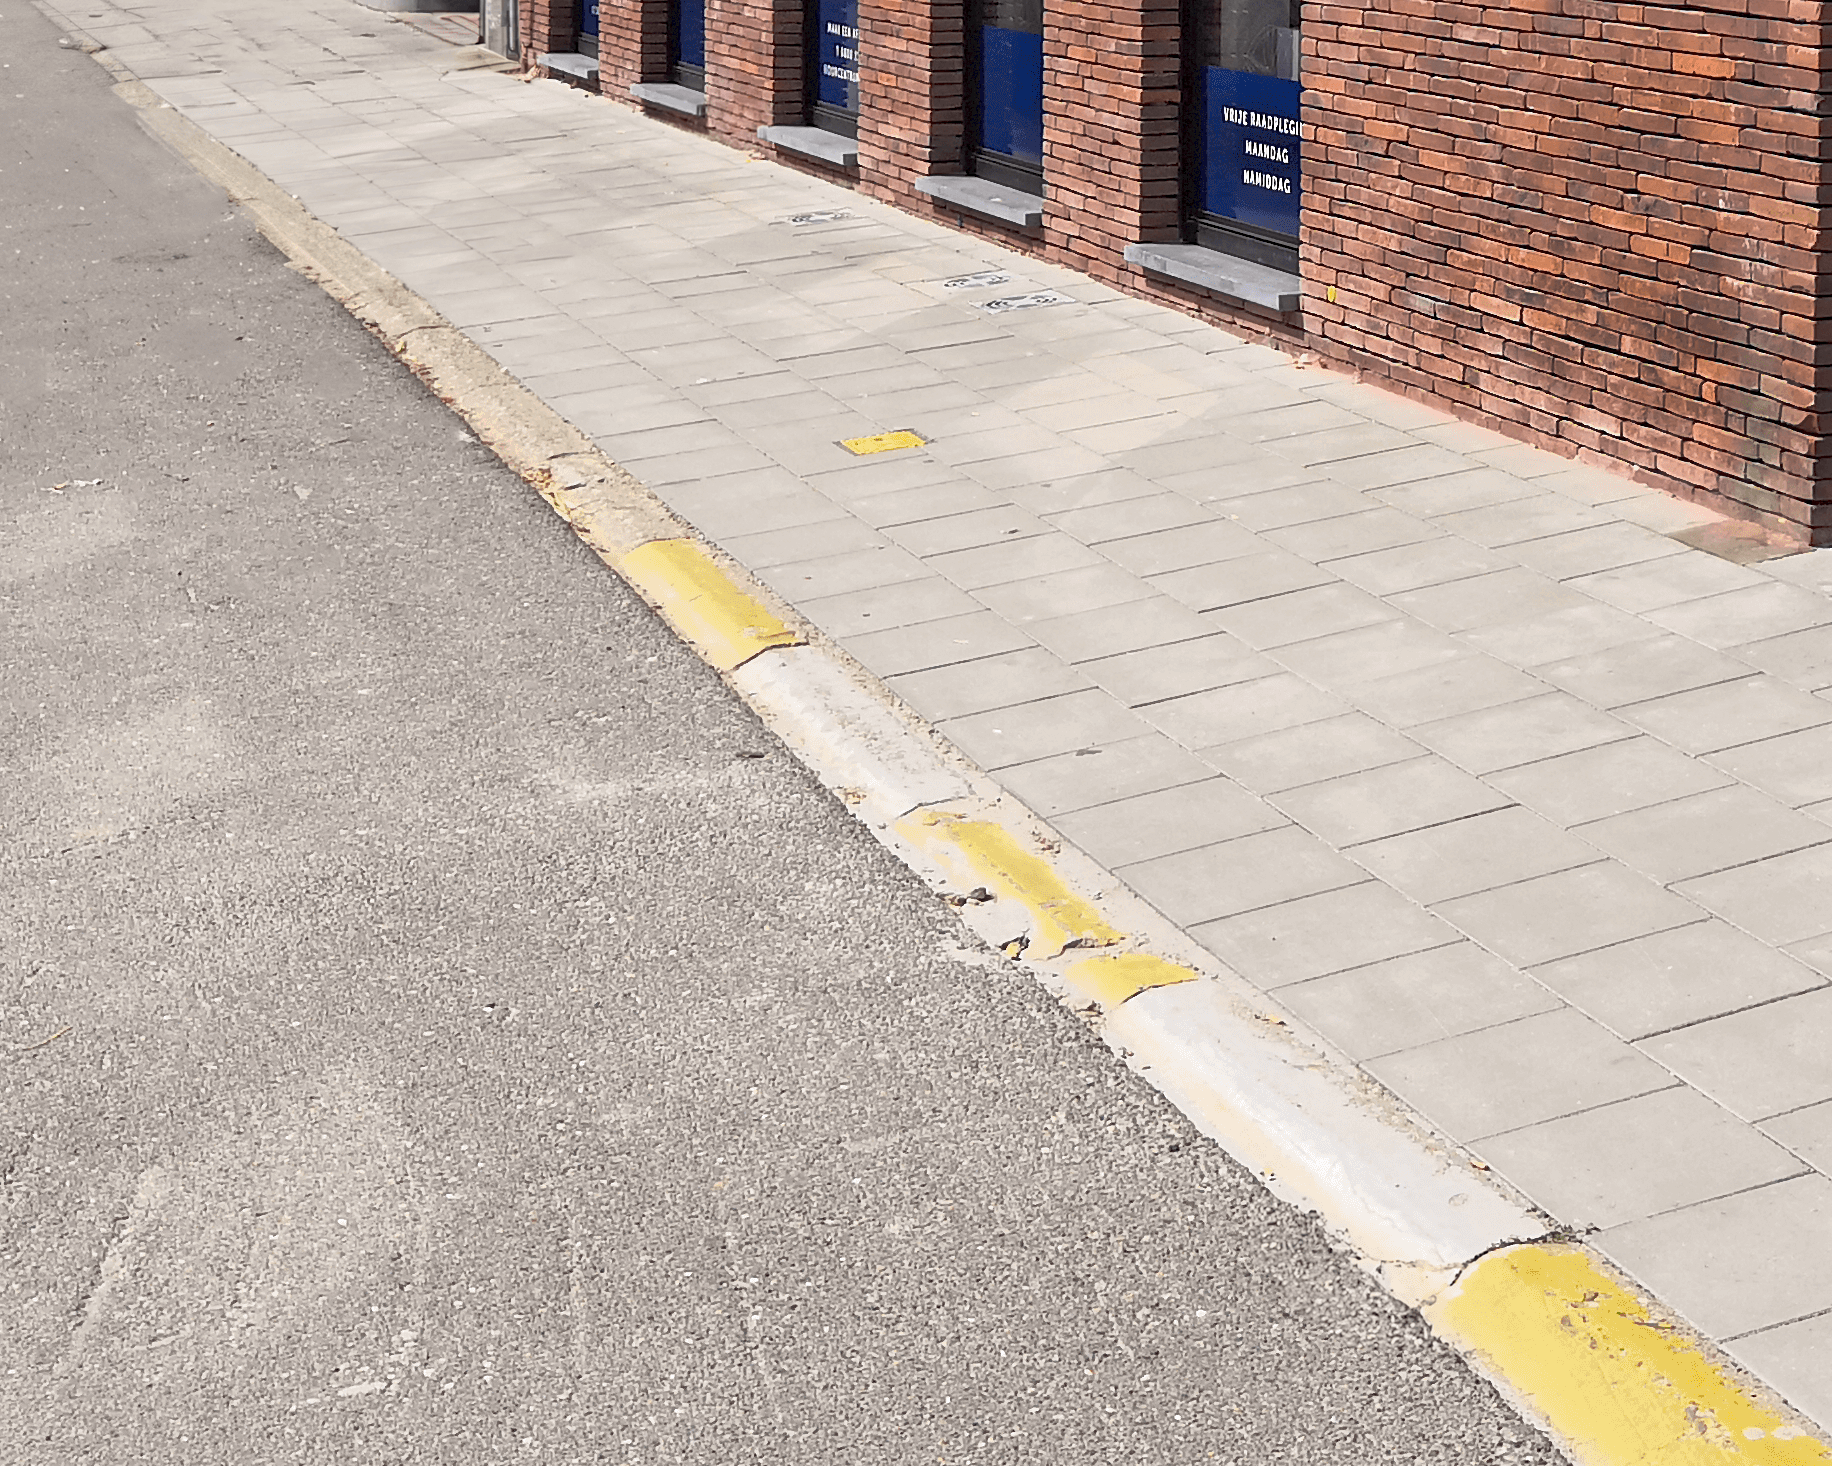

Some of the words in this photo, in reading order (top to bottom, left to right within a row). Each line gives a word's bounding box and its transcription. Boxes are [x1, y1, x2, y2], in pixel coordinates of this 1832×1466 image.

[1223, 105, 1248, 126] VRIJE
[1244, 139, 1289, 164] MAANDAG
[1243, 169, 1292, 194] NAMIDDAG
